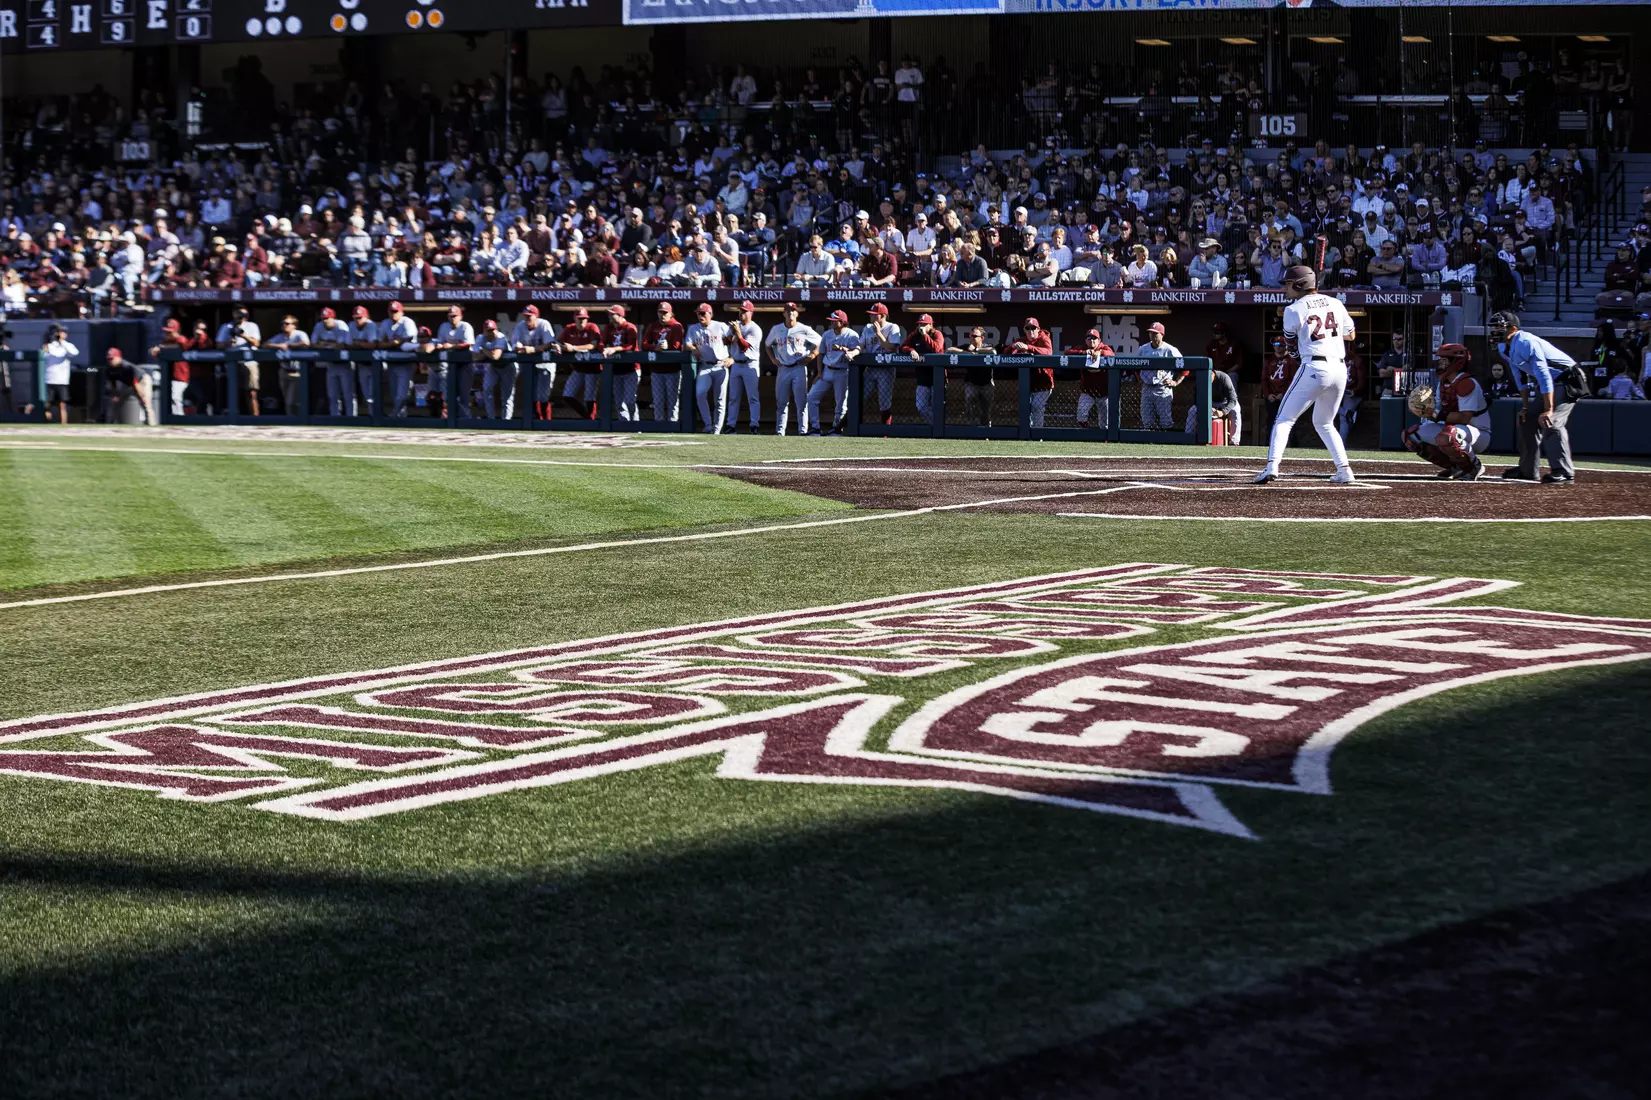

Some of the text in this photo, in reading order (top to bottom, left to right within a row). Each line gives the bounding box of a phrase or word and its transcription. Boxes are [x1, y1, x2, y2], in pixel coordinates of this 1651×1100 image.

[71, 5, 93, 33] H
[147, 1, 168, 29] E
[0, 10, 18, 38] R
[186, 17, 201, 36] 0
[40, 26, 55, 45] 4
[111, 22, 125, 41] 9
[1260, 115, 1296, 135] 105
[437, 290, 493, 299] #HAILSTATE
[531, 290, 580, 299] BANKFIRST
[621, 290, 692, 300] HAILSTATE.COM
[732, 290, 784, 300] BANKFIRST
[826, 290, 887, 300] #HAILSTATE
[930, 290, 984, 300] BANKFIRST
[1028, 291, 1106, 301] HAILSTATE.COM
[1151, 292, 1207, 302] BANKFIRST
[1253, 293, 1293, 303] #HAIL
[1365, 293, 1423, 304] BANKFIRST
[1306, 297, 1329, 310] ALFORD
[1306, 311, 1339, 342] 24
[1001, 356, 1035, 364] MISSISSIPPI
[1115, 358, 1150, 366] MISSISSIPPI
[0, 565, 1438, 802] MISSISSIPPI
[979, 627, 1634, 758] STATE
